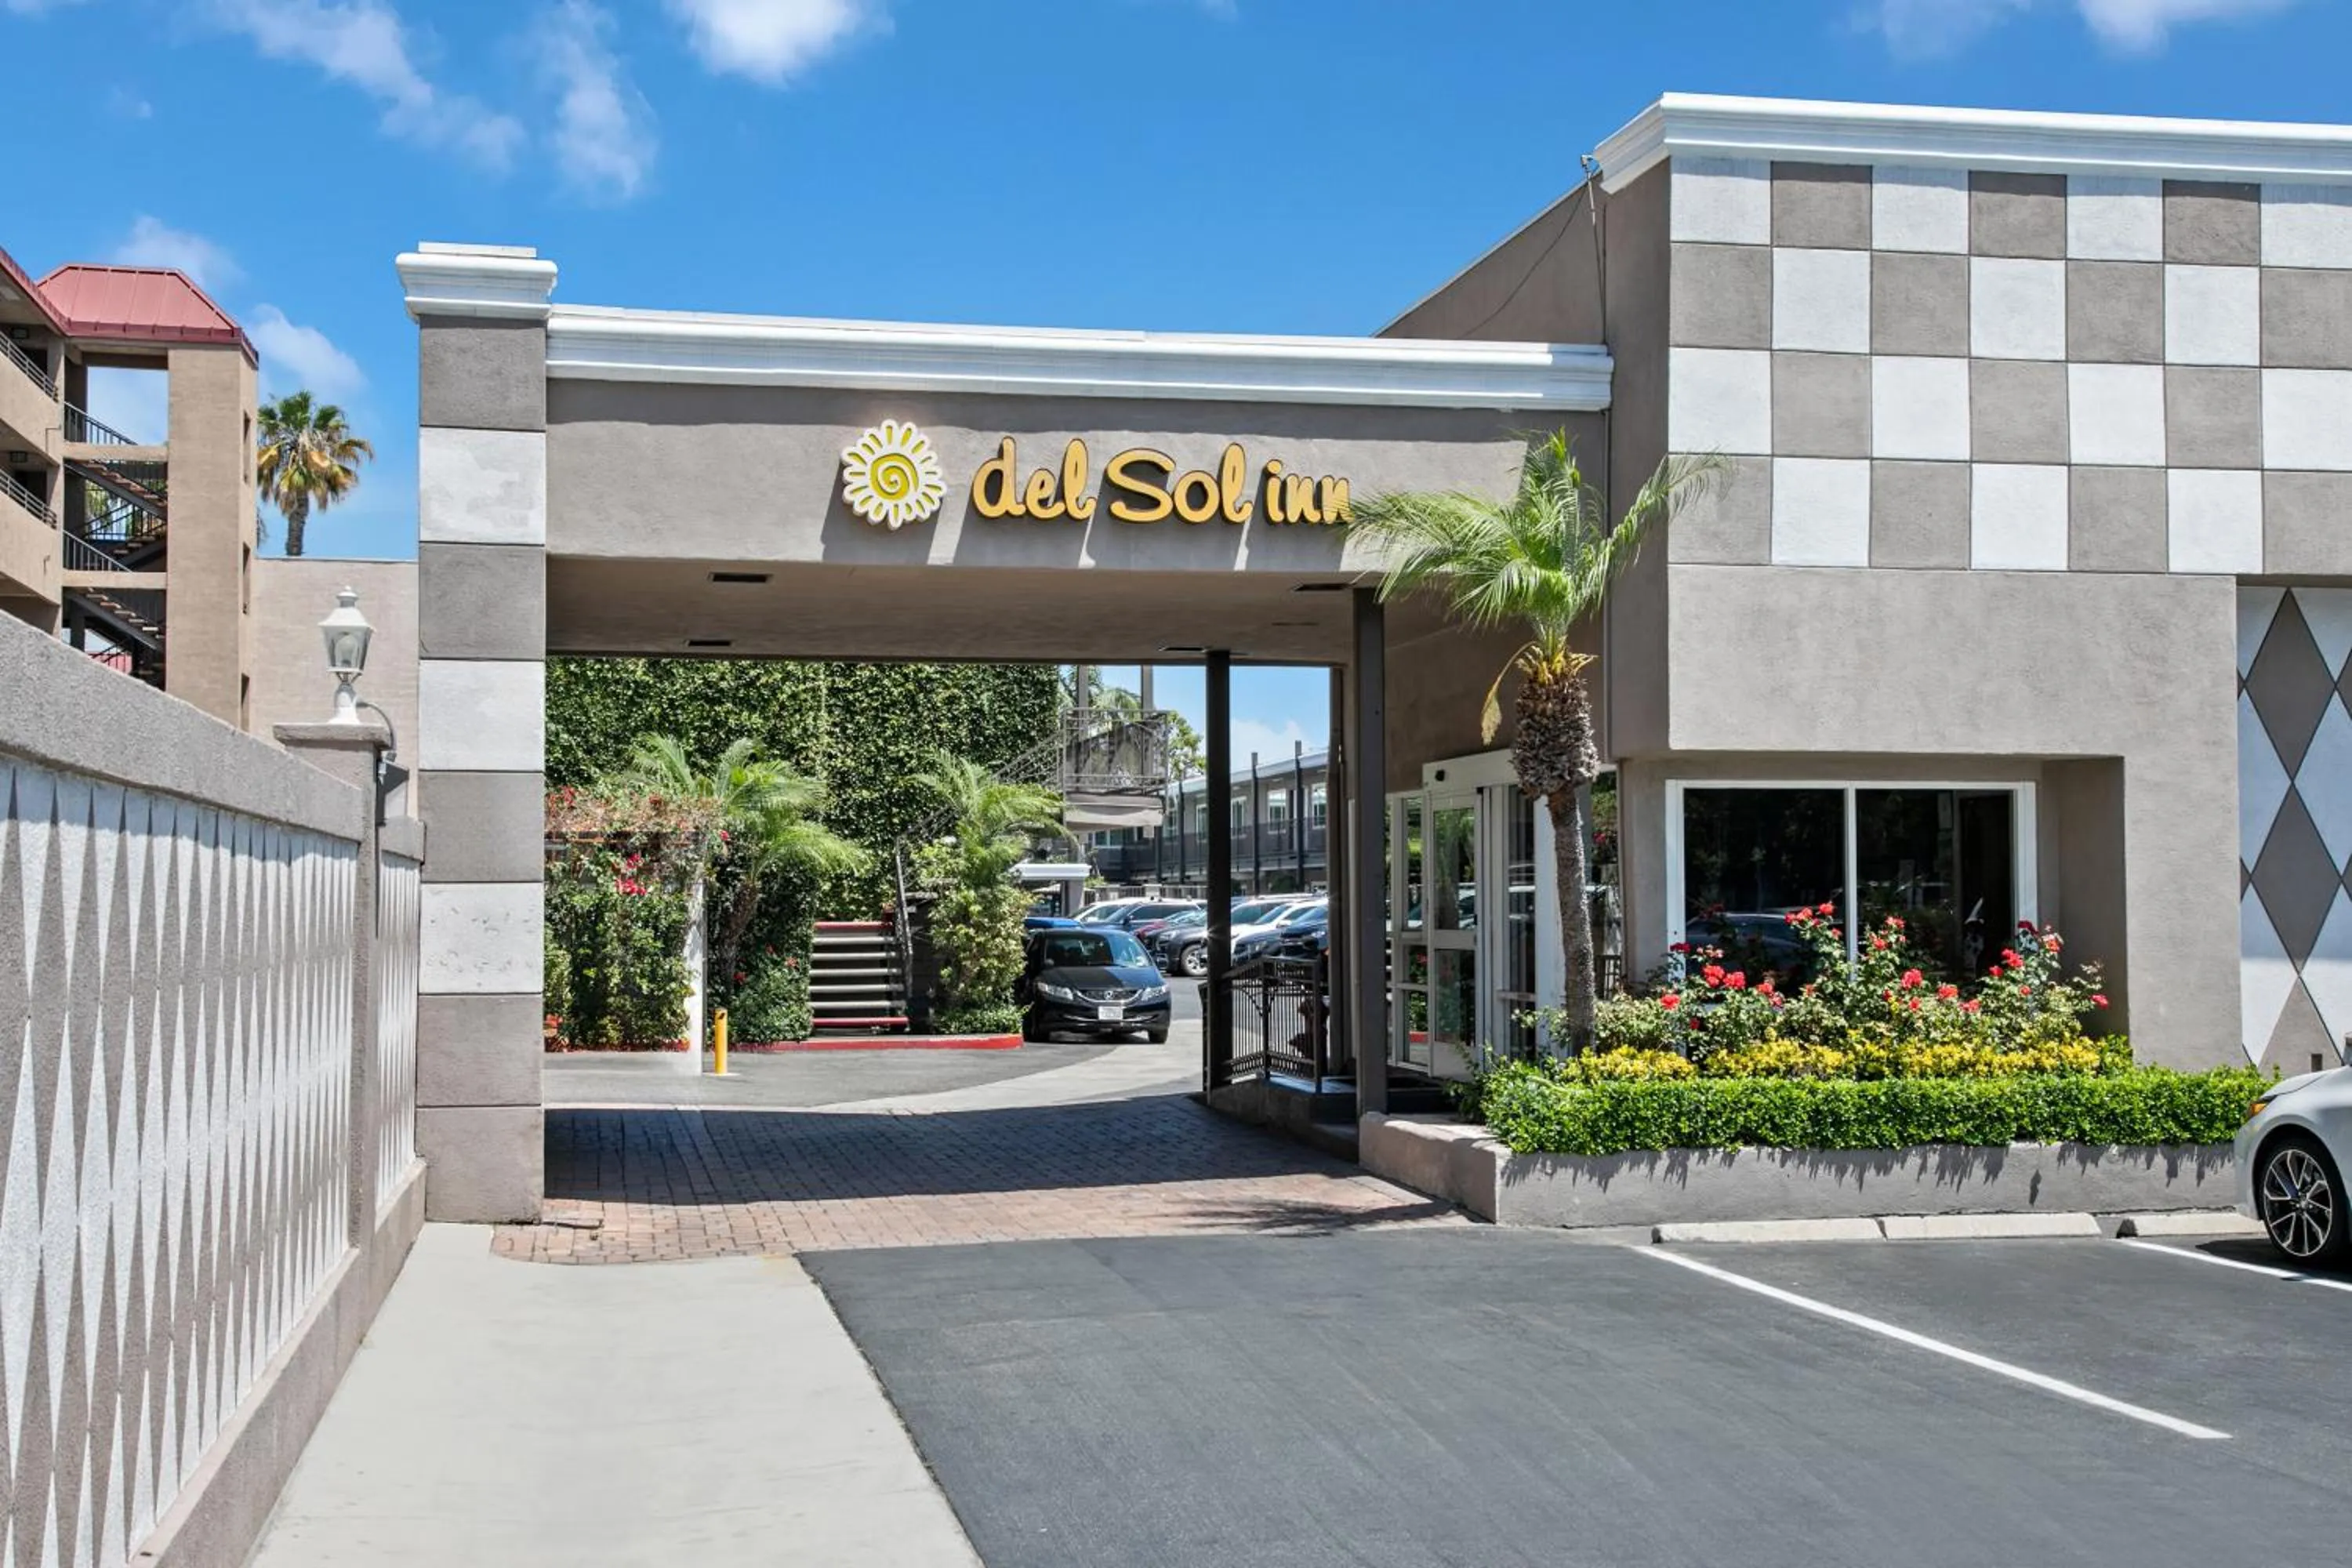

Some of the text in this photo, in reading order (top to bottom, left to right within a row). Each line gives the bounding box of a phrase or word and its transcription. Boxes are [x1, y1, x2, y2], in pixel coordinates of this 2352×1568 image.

[972, 436, 1355, 524] del Sol inn
